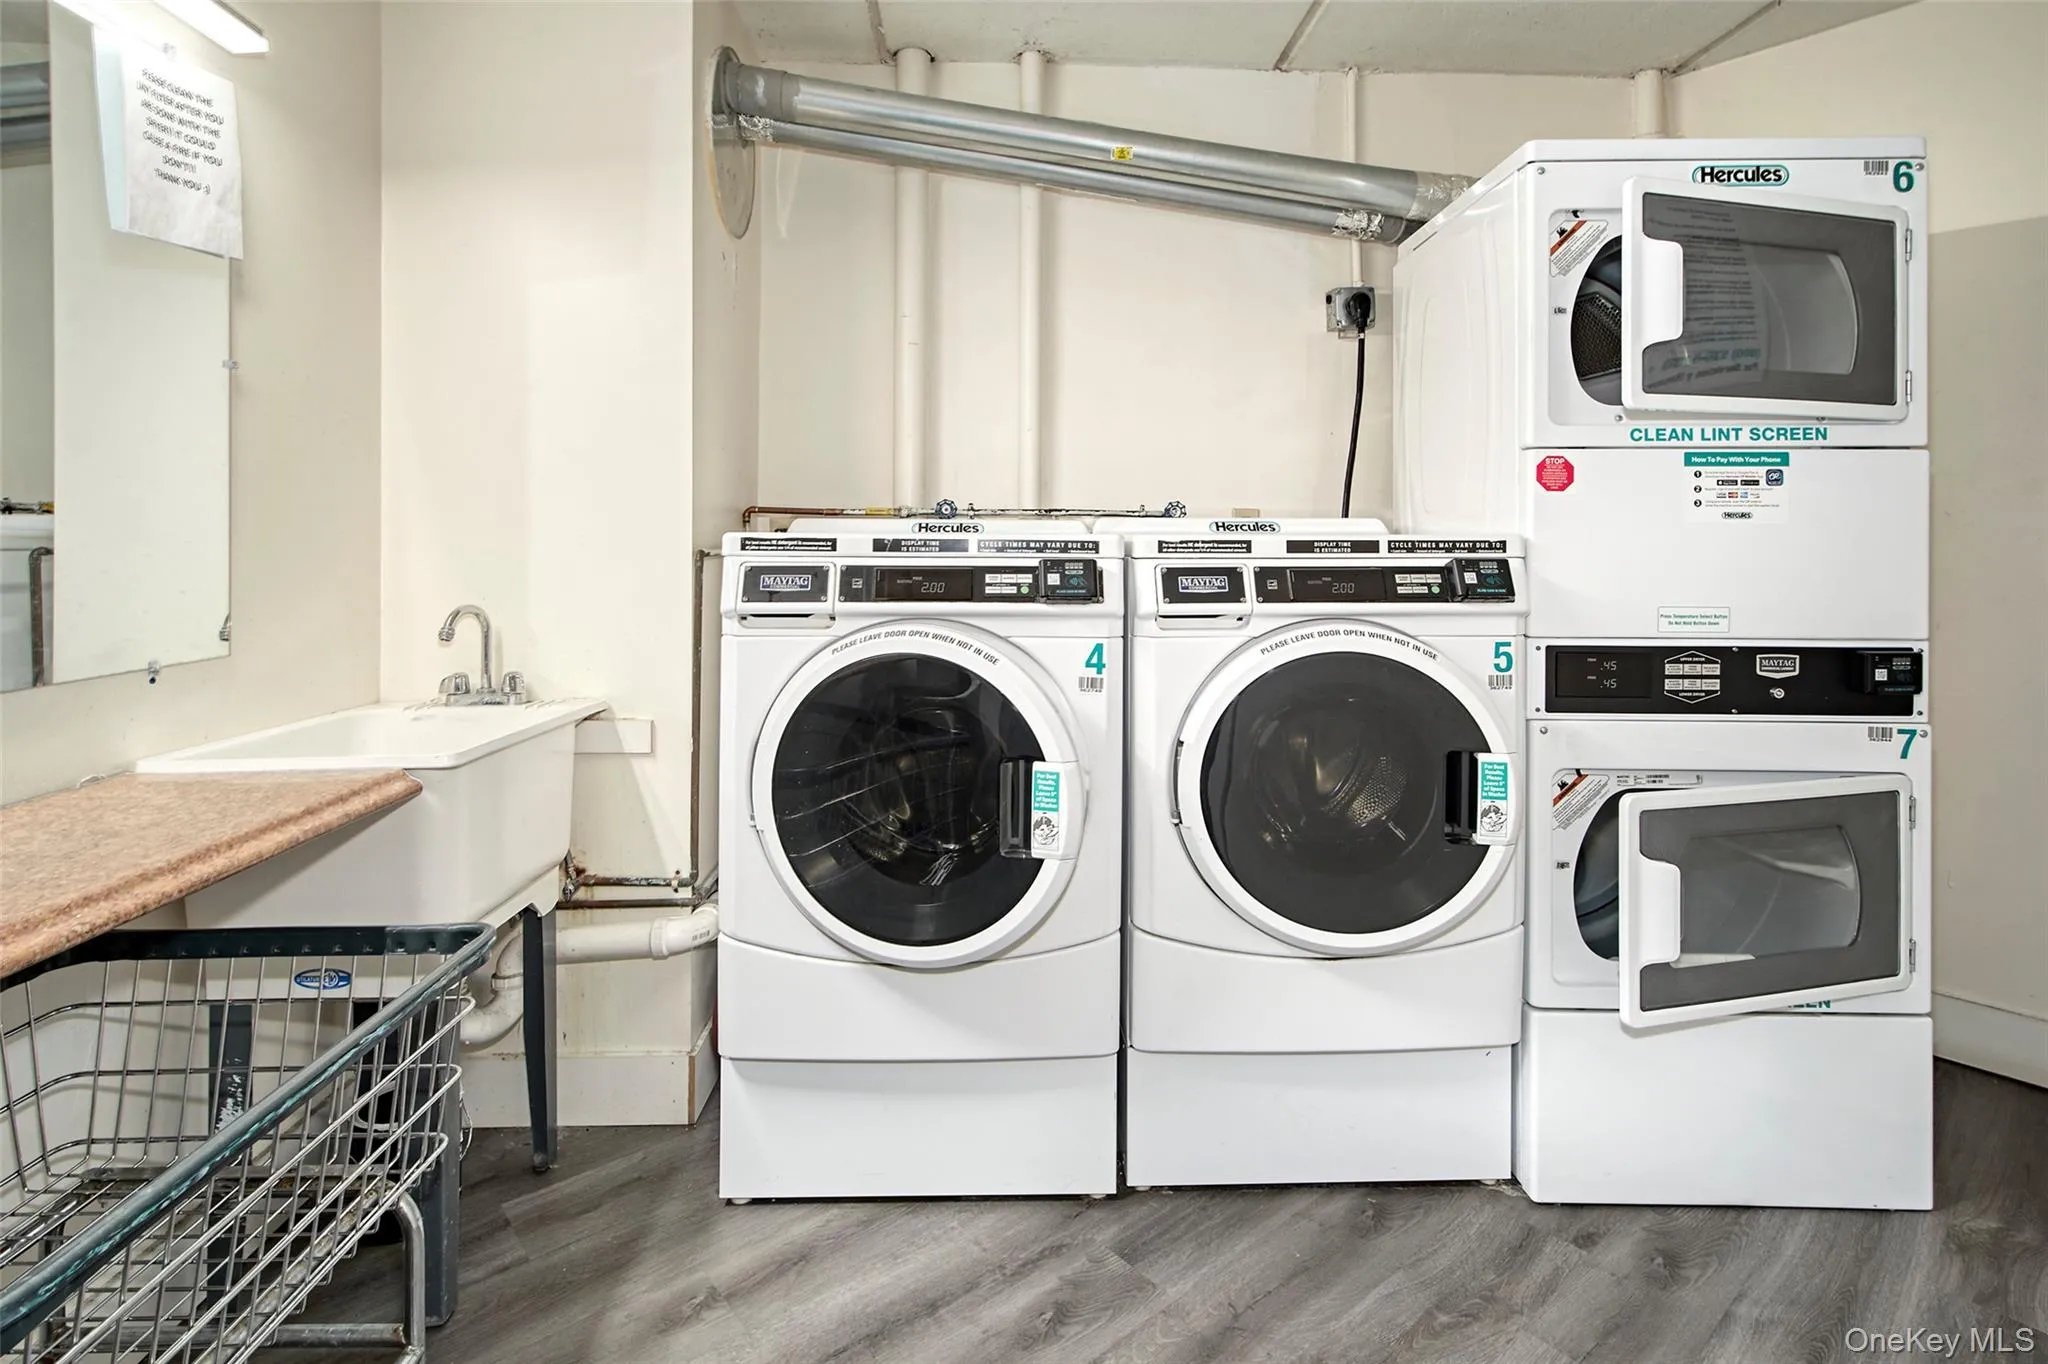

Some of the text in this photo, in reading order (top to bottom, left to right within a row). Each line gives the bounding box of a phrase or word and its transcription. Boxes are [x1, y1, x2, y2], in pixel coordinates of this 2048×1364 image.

[166, 82, 193, 100] CLEAN
[195, 93, 213, 108] THE
[175, 101, 203, 119] AFTER
[203, 111, 224, 126] YOU
[184, 133, 216, 151] COULD
[202, 154, 223, 167] YOU
[1700, 165, 1783, 184] Hercules
[1892, 160, 1915, 193] 6
[1629, 427, 1828, 442] CLEAN LINT SCREEN
[1545, 457, 1565, 465] STOP
[1716, 456, 1728, 464] Pay
[918, 522, 980, 534] Hercules
[1214, 521, 1276, 533] Hercules
[763, 576, 808, 586] MAYTAG
[921, 582, 945, 593] 2.00
[1181, 578, 1225, 587] MAYTAG
[1331, 582, 1355, 594] 2.00
[831, 630, 1000, 666] PLEASE LEAVE DOOR OPEN WHEN NOT IN USE
[1260, 629, 1439, 661] PLEASE LEAVE DOOR OPEN WHEN NOT IN USE
[1085, 642, 1106, 675] 4
[1493, 641, 1514, 673] 5
[1761, 659, 1795, 667] MAYTAG
[1896, 728, 1918, 760] 7
